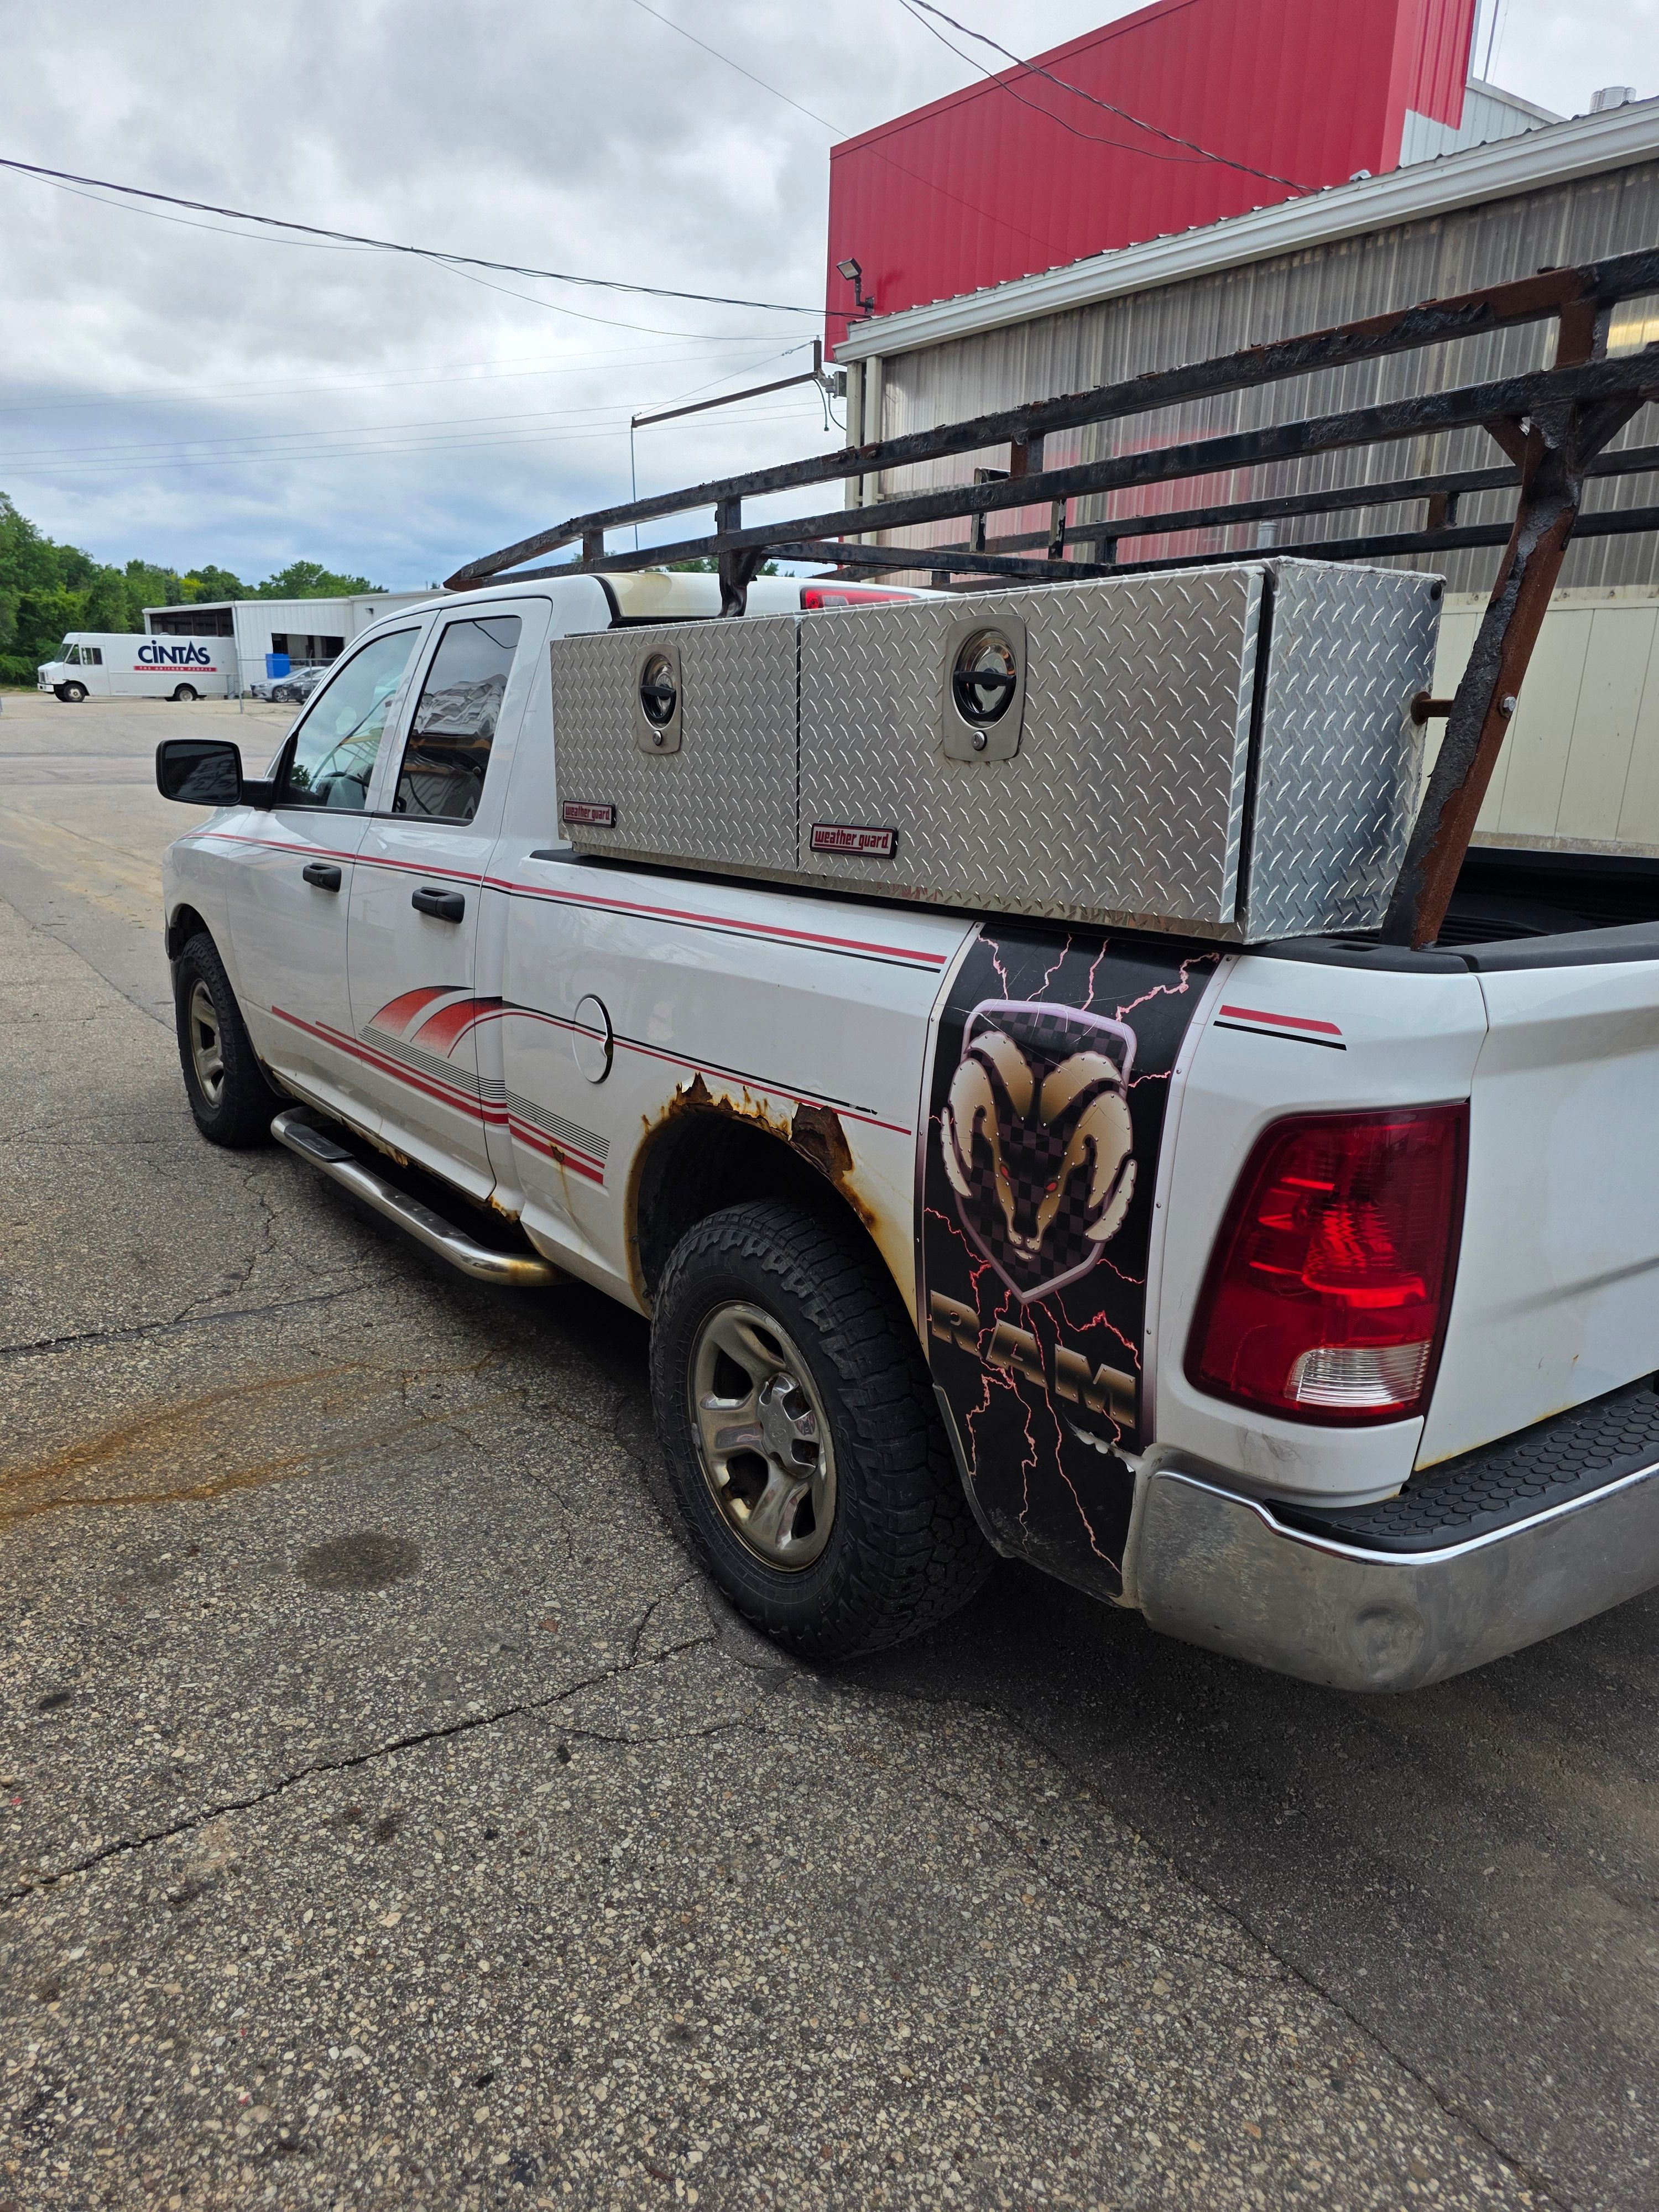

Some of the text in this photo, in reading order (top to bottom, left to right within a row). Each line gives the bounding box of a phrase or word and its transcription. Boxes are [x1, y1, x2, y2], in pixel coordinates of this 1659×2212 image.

[565, 806, 610, 821] weather guard
[815, 830, 889, 850] weather guard
[931, 1290, 1136, 1430] RAM
